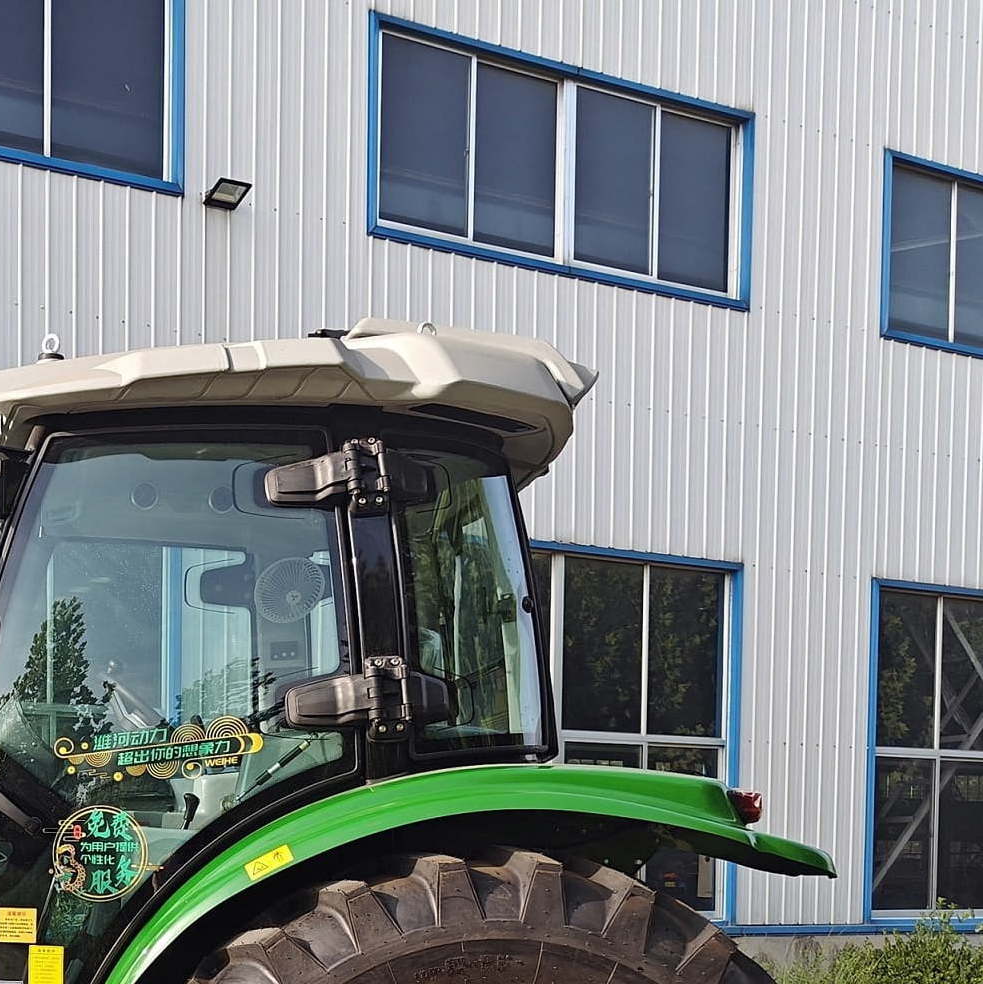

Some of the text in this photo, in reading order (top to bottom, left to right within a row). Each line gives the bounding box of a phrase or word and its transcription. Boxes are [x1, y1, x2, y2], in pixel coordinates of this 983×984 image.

[117, 740, 231, 766] 超出你的想象力
[204, 756, 239, 768] WEIHE
[84, 808, 134, 841] 免费
[80, 841, 138, 853] 为用户提供
[80, 854, 116, 865] 个性化
[88, 854, 138, 895] 服务
